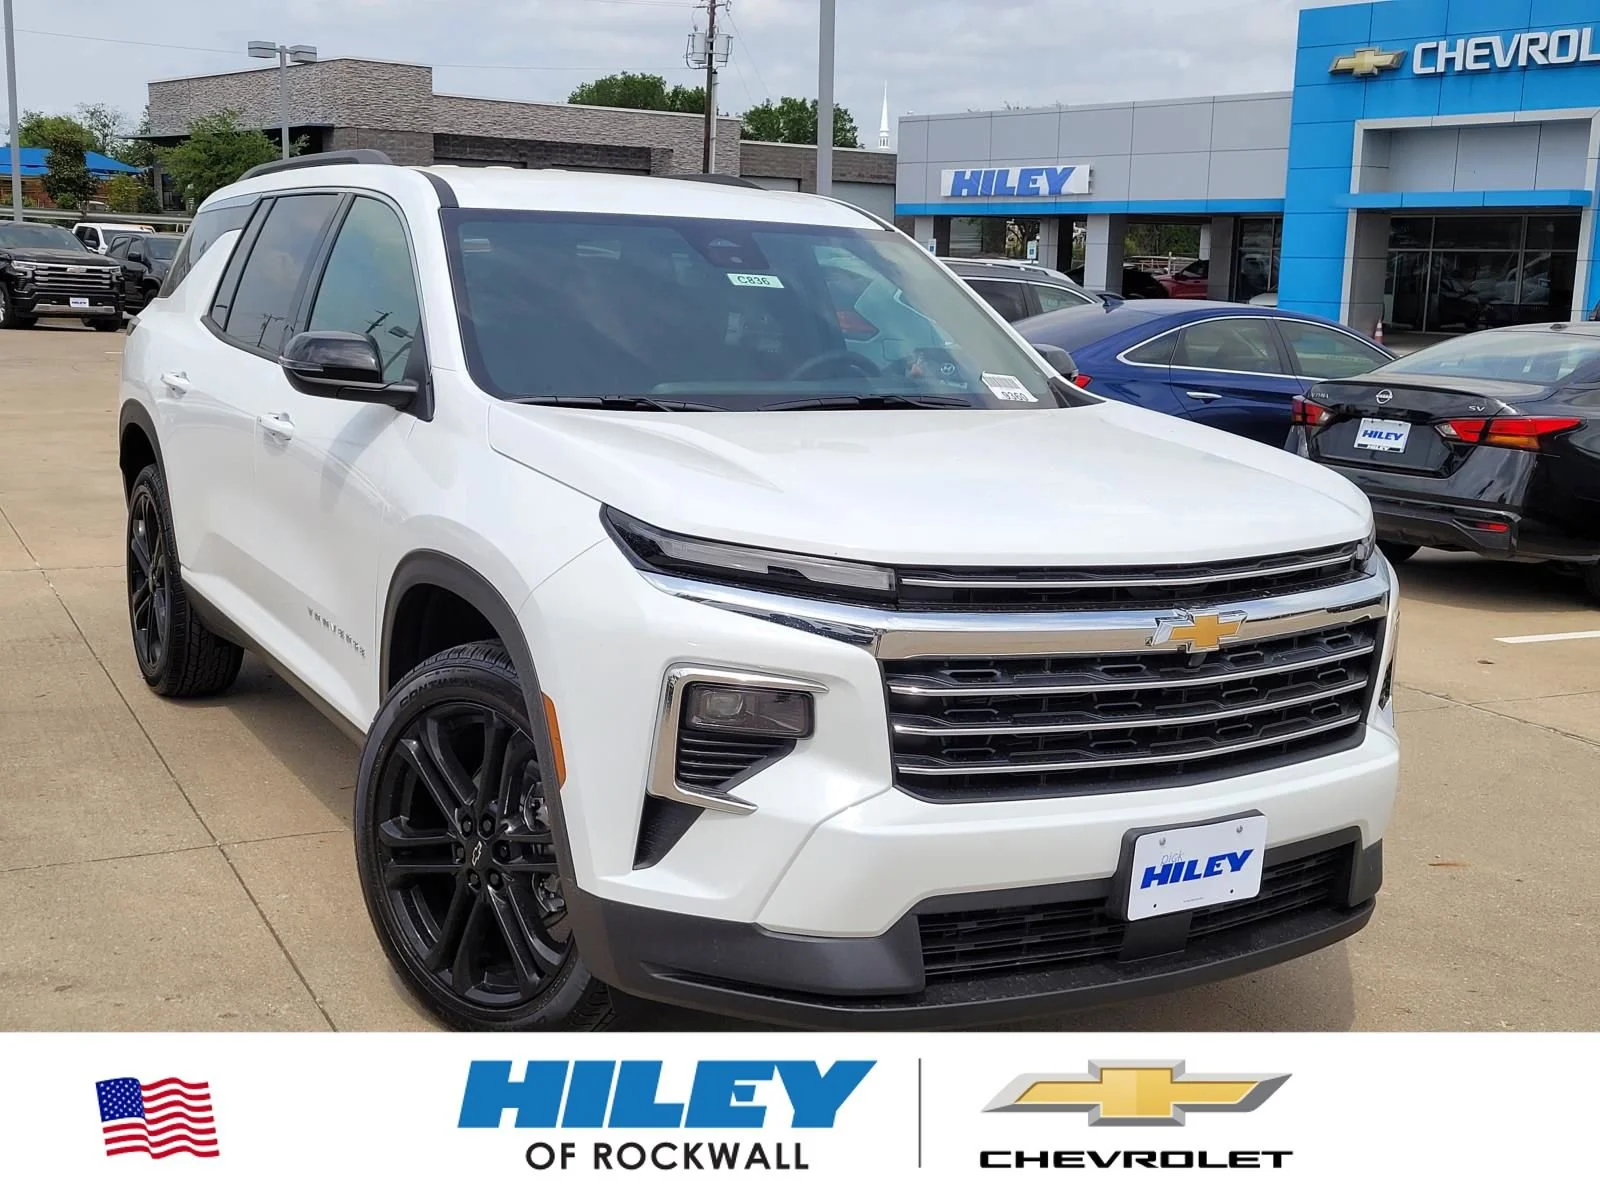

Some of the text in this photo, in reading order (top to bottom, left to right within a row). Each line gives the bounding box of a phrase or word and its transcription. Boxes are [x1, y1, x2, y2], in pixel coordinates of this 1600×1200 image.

[951, 166, 1076, 197] HILEY
[737, 275, 770, 286] C836
[1361, 430, 1404, 441] HILEY
[1140, 848, 1254, 889] HILEY
